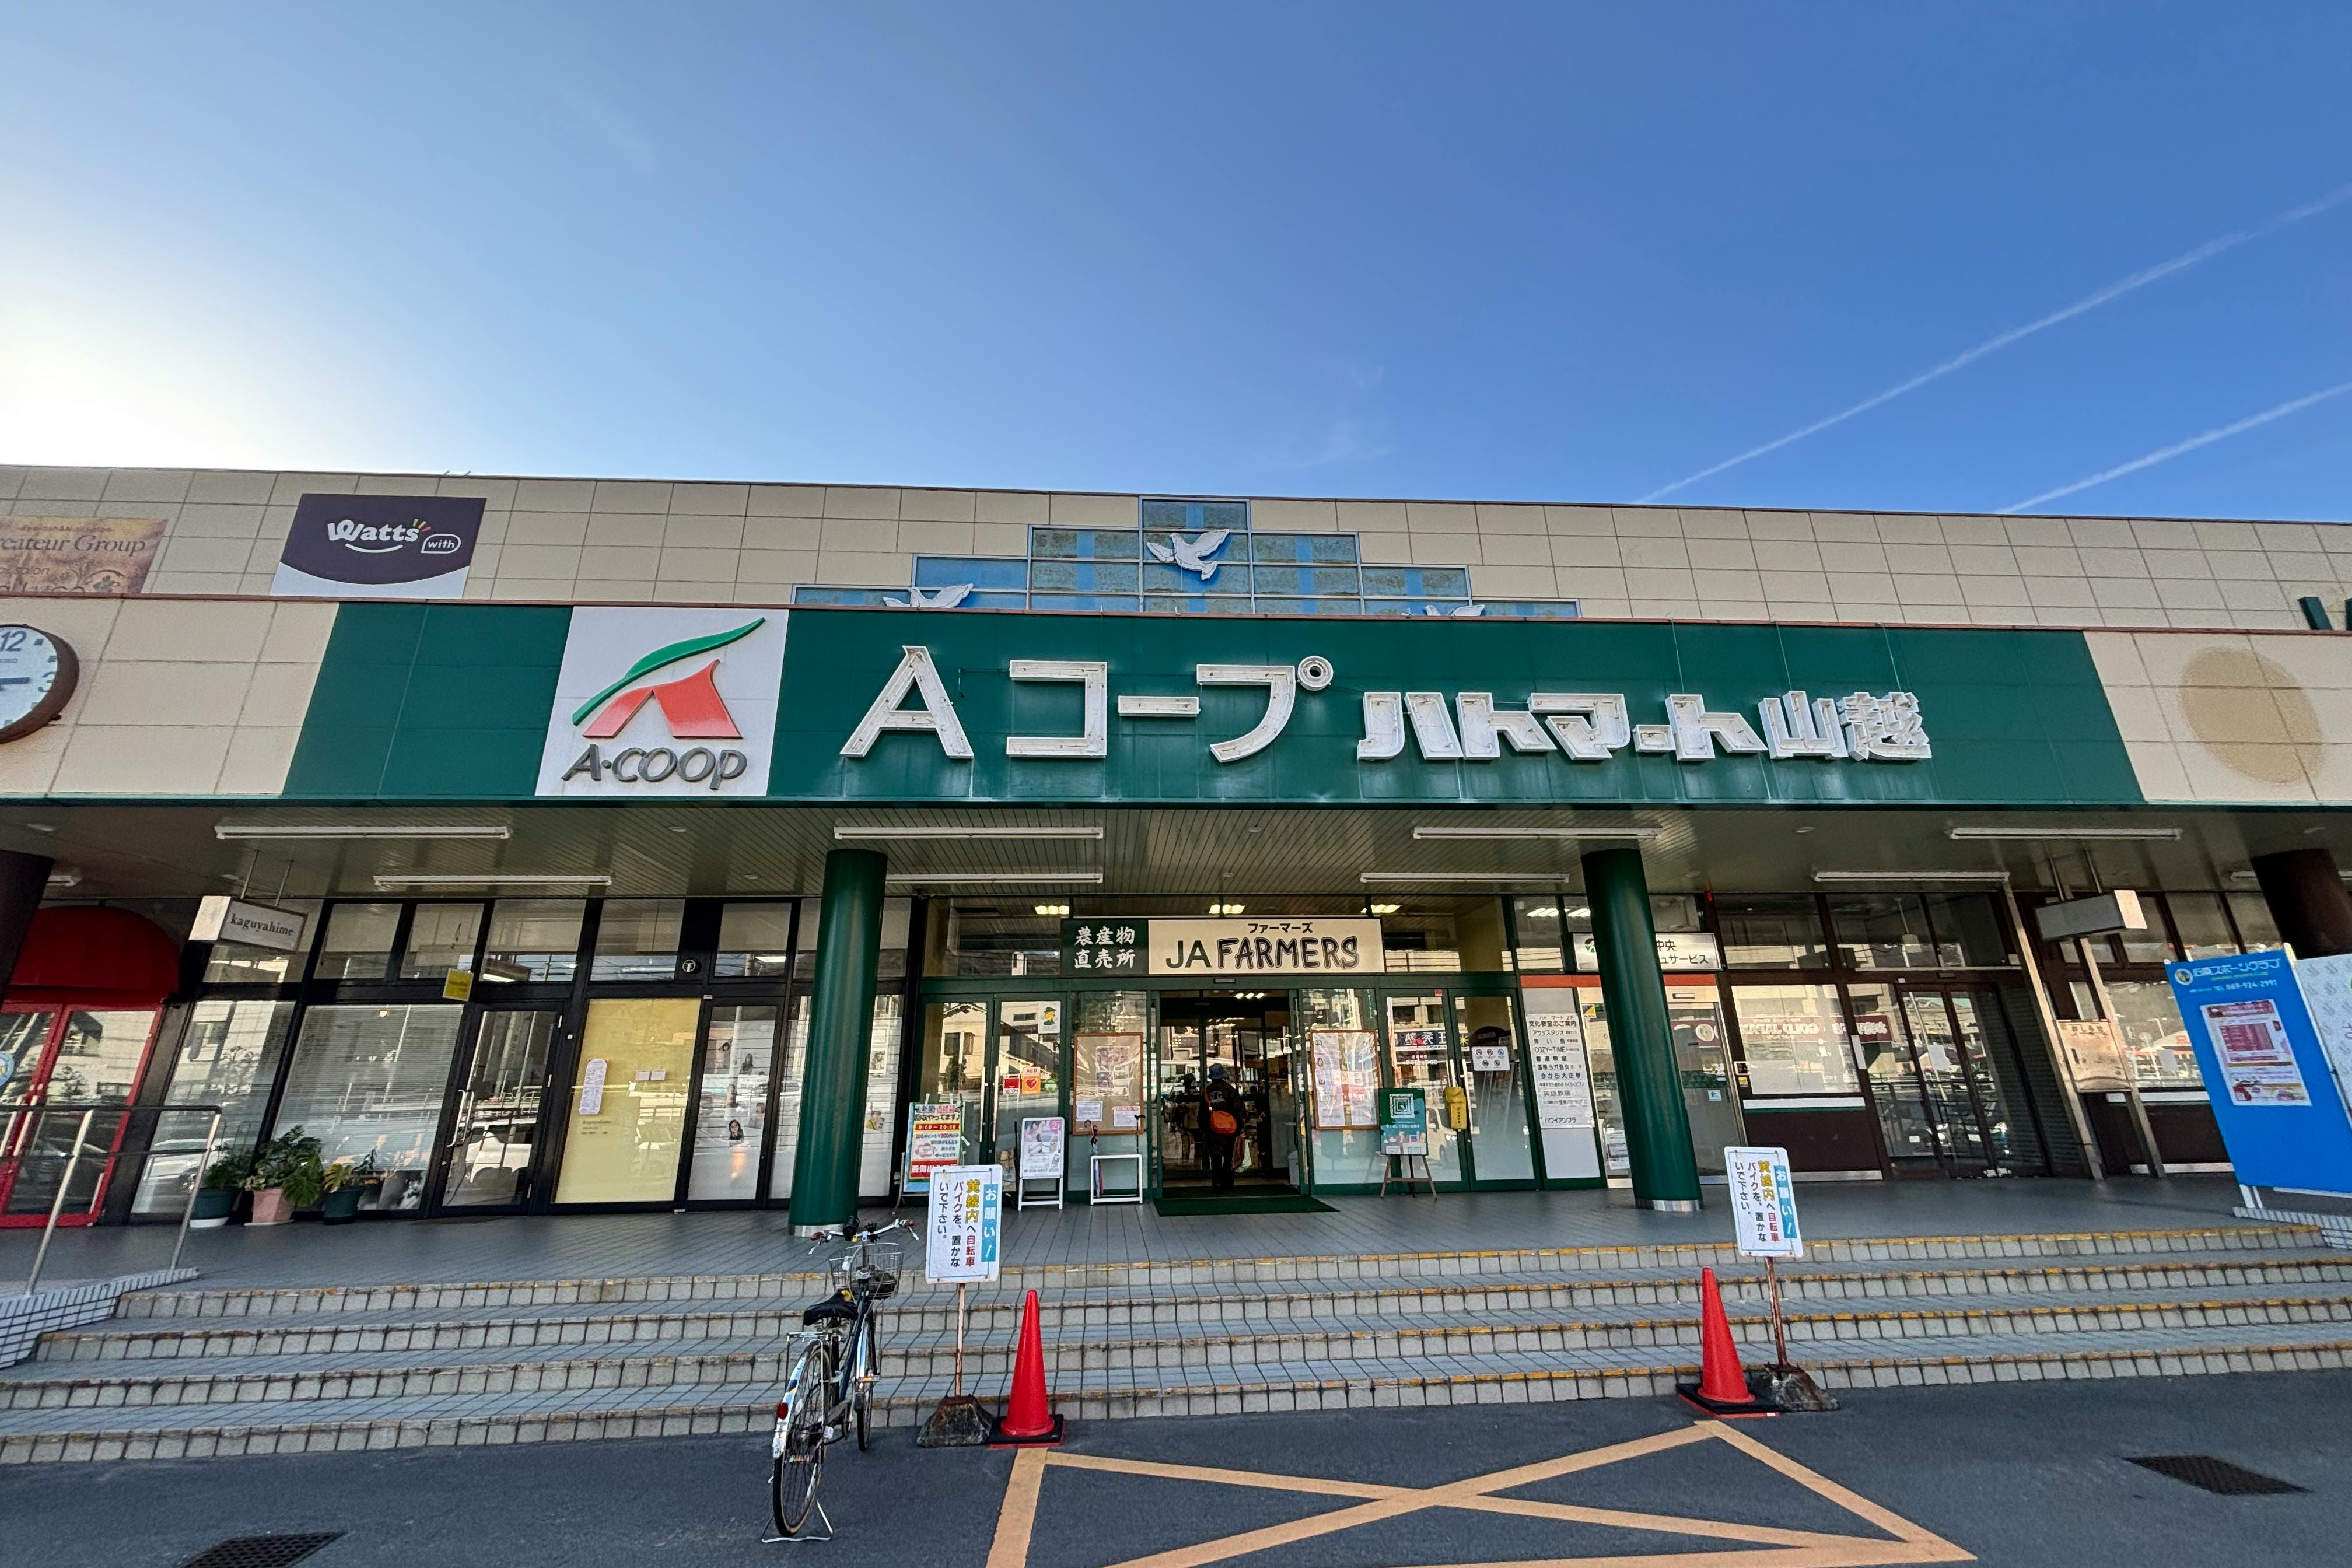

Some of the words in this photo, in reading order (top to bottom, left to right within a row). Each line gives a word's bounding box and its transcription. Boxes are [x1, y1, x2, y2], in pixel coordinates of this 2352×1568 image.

[327, 519, 419, 541] Watts
[74, 534, 146, 557] Group
[428, 539, 455, 549] with
[840, 645, 1334, 763] Aコープ
[230, 913, 295, 936] kaguyahime
[1247, 922, 1313, 935] ファーマーズ
[1074, 926, 1136, 946] 農産物
[1074, 949, 1136, 970] 直売所
[1166, 940, 1212, 969] JA
[1216, 936, 1360, 970] FARMERS
